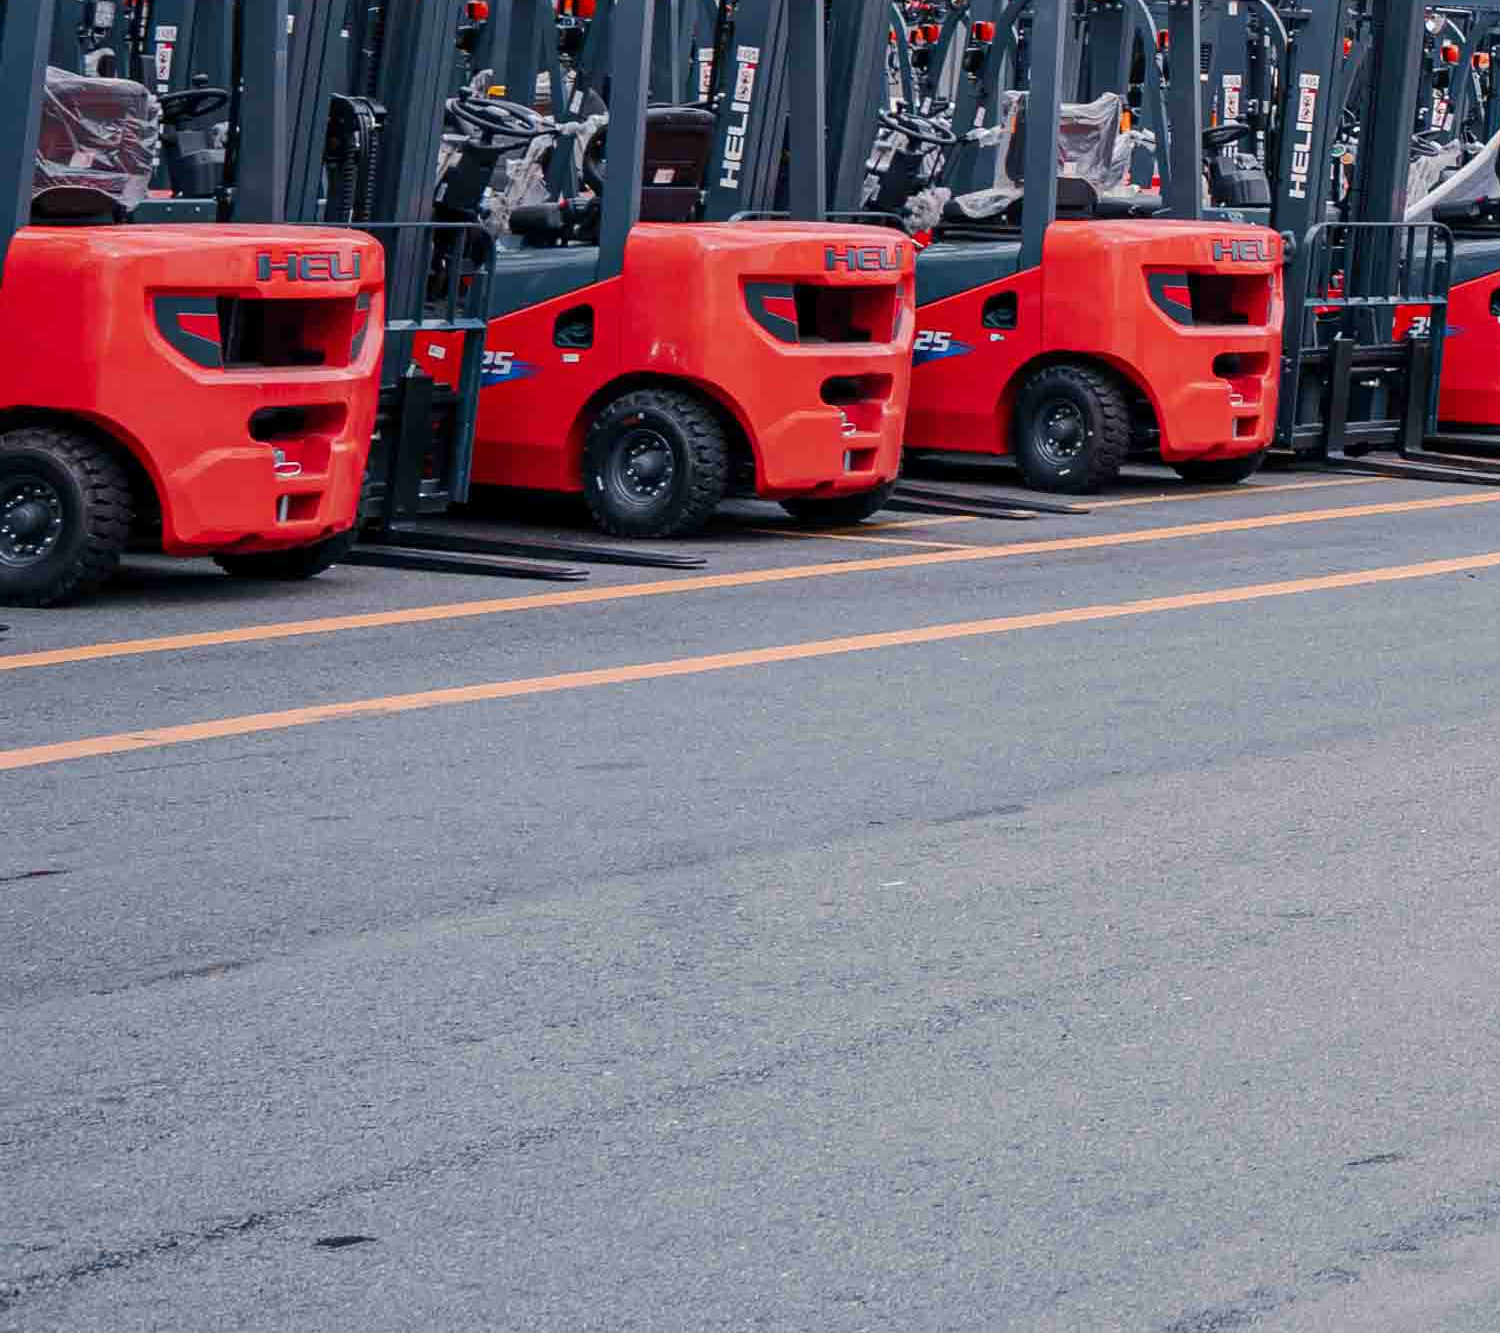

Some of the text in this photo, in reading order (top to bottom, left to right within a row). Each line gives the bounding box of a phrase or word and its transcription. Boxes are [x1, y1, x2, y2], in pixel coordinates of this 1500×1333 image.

[719, 101, 750, 190] HELI
[1288, 121, 1314, 199] HELI
[824, 245, 904, 271] HELI
[1213, 237, 1276, 263] HELI
[257, 252, 361, 282] HELI
[914, 329, 952, 352] 25
